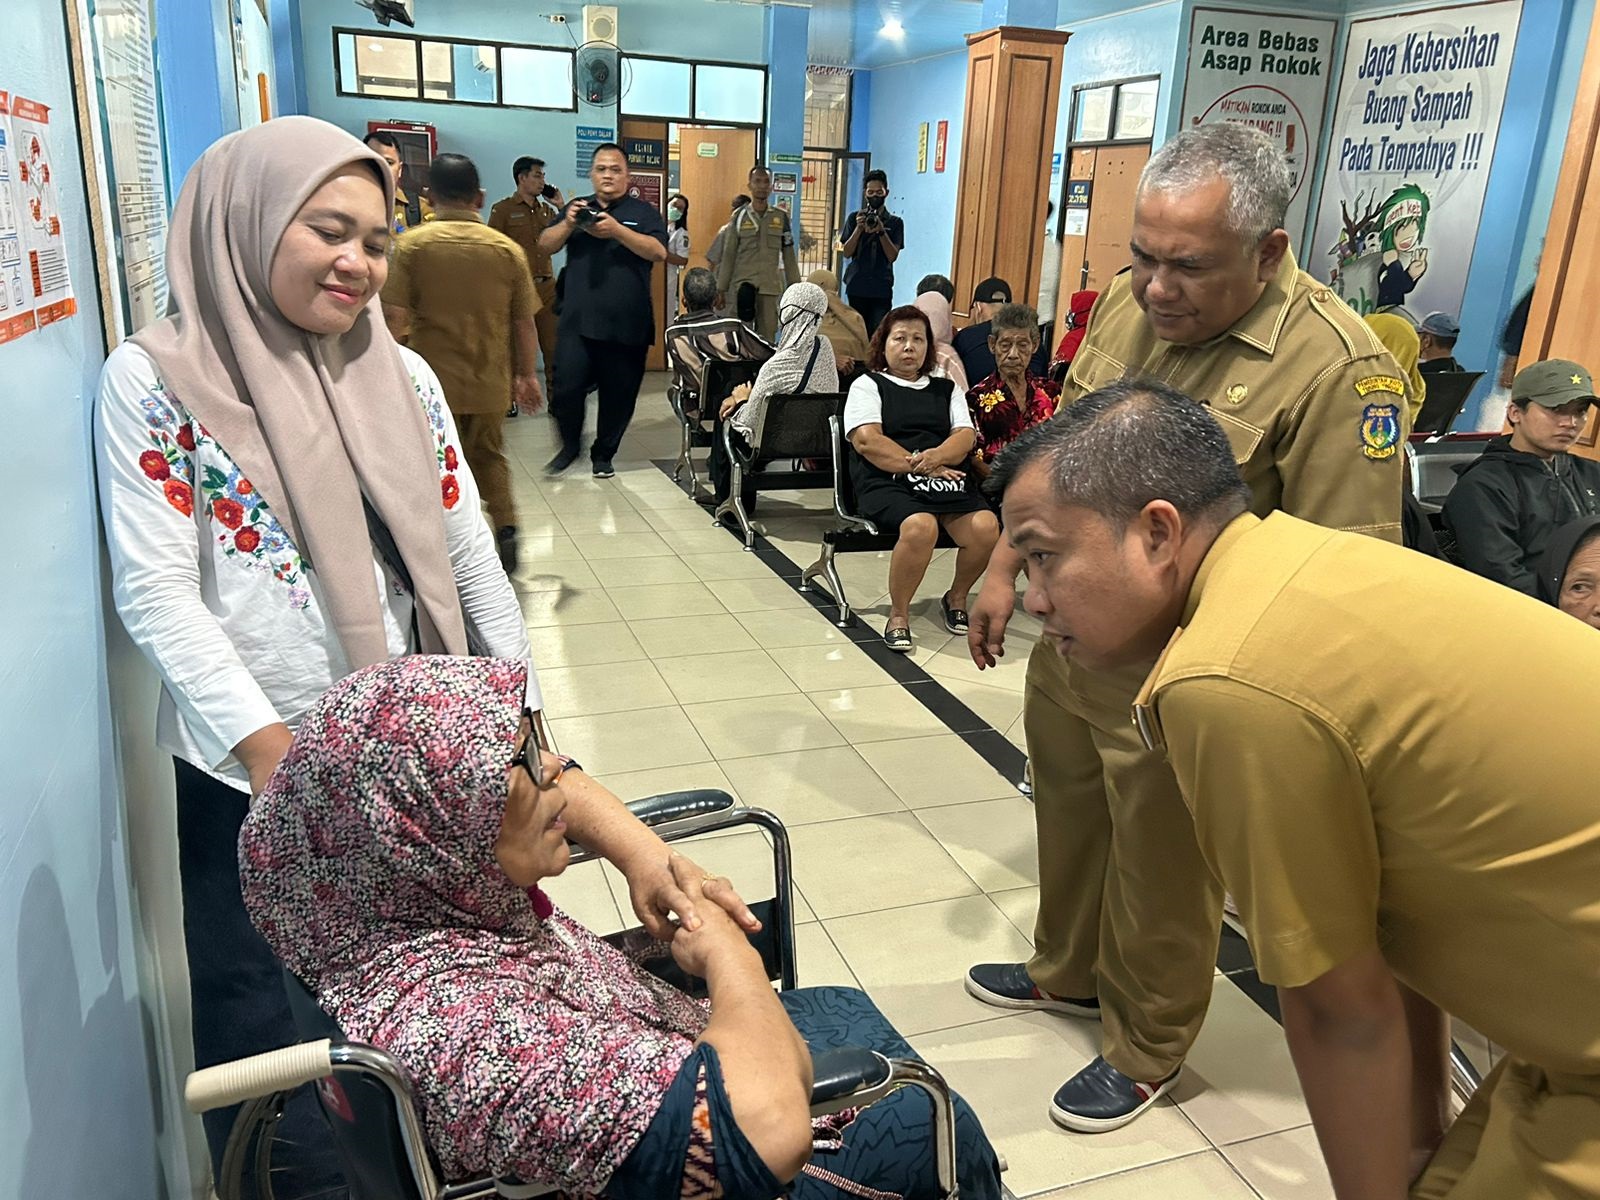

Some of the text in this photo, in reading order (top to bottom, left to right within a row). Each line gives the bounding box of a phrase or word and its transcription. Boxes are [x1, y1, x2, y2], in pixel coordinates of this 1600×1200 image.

[1200, 25, 1319, 53] Area Bebas
[1358, 25, 1500, 86] Jaga Kebersihan
[1200, 49, 1322, 77] Asap Rokok
[1362, 82, 1473, 131] Buang Sampah
[1338, 132, 1484, 179] Pada Tempatnya !!!
